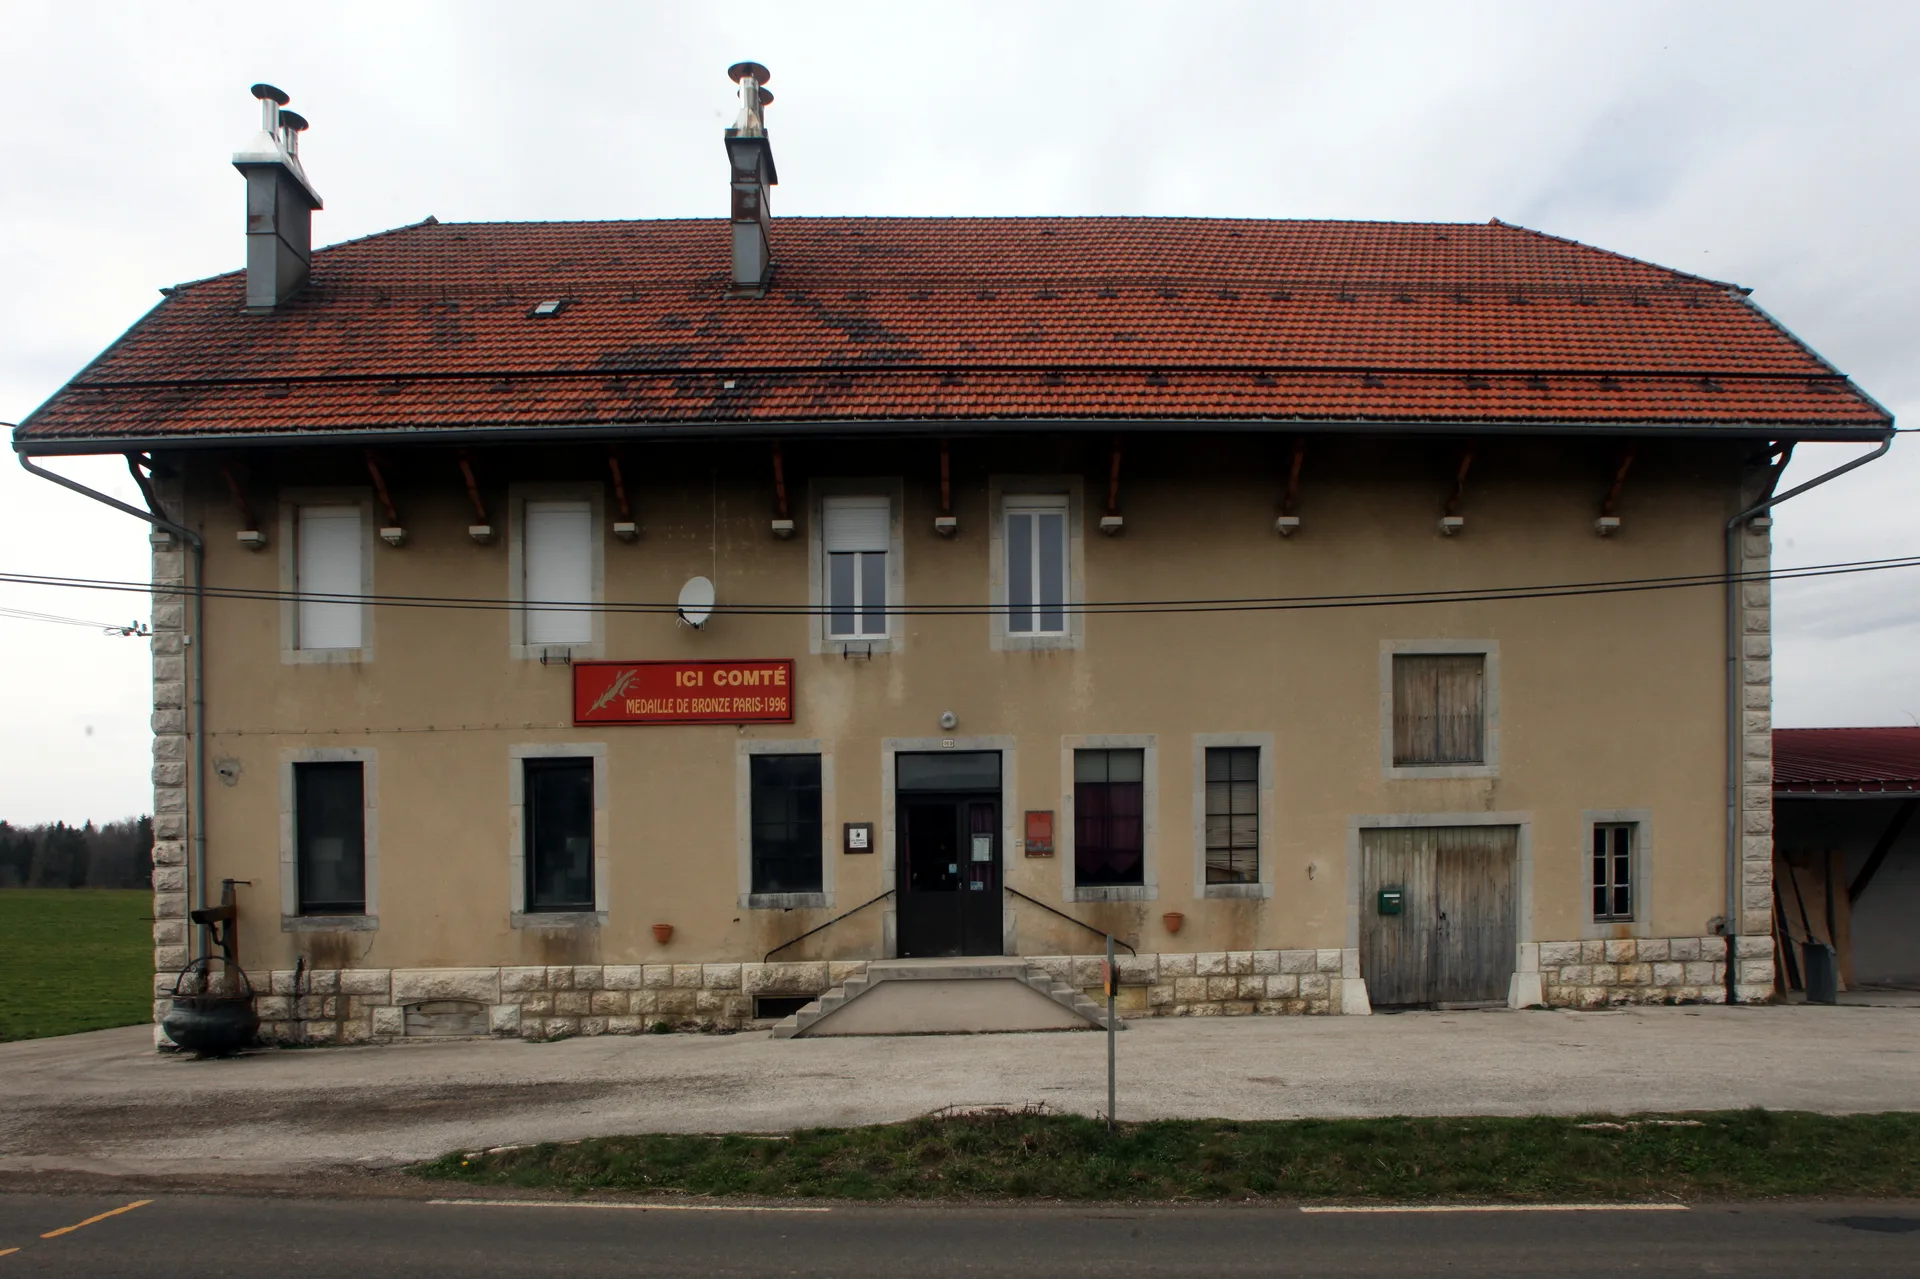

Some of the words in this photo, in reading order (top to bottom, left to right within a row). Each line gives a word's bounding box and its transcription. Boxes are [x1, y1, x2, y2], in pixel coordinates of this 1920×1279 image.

[676, 670, 703, 687] ICI
[713, 666, 786, 686] COMTÉ
[626, 698, 674, 714] MEDAILLE
[677, 698, 689, 713] DE
[692, 698, 730, 713] BRONZE
